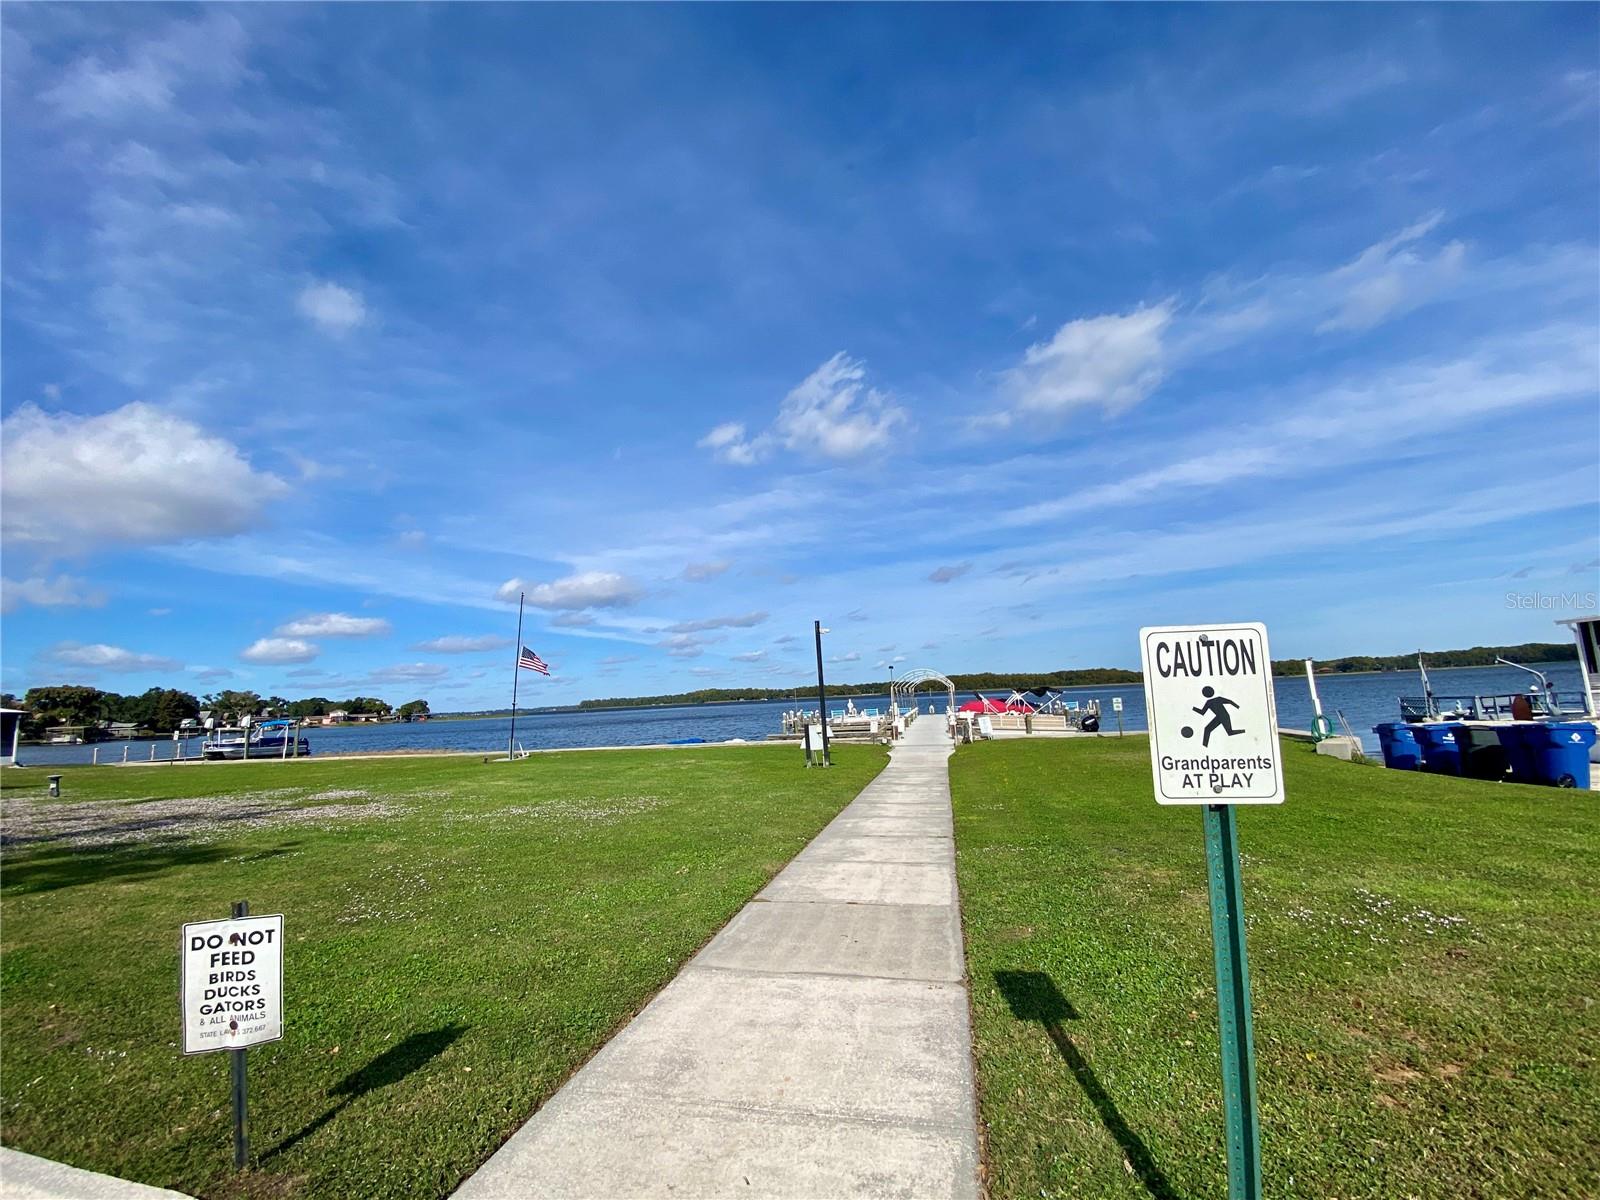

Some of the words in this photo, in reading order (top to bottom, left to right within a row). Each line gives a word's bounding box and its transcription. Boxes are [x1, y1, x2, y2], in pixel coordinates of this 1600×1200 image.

[1156, 639, 1257, 678] CAUTION
[1161, 755, 1272, 772] Grandparents
[1182, 774, 1203, 789] AT
[1209, 773, 1254, 789] PLAY
[191, 934, 223, 951] DO
[232, 929, 275, 946] NOT
[210, 950, 255, 968] FEED
[209, 970, 256, 985] BIRDS
[204, 984, 261, 1000] DUCKS
[199, 998, 266, 1015] GATORS
[199, 1018, 205, 1026] &
[209, 1016, 226, 1025] ALL
[229, 1011, 266, 1023] ANIMALS
[199, 1031, 217, 1039] STATE
